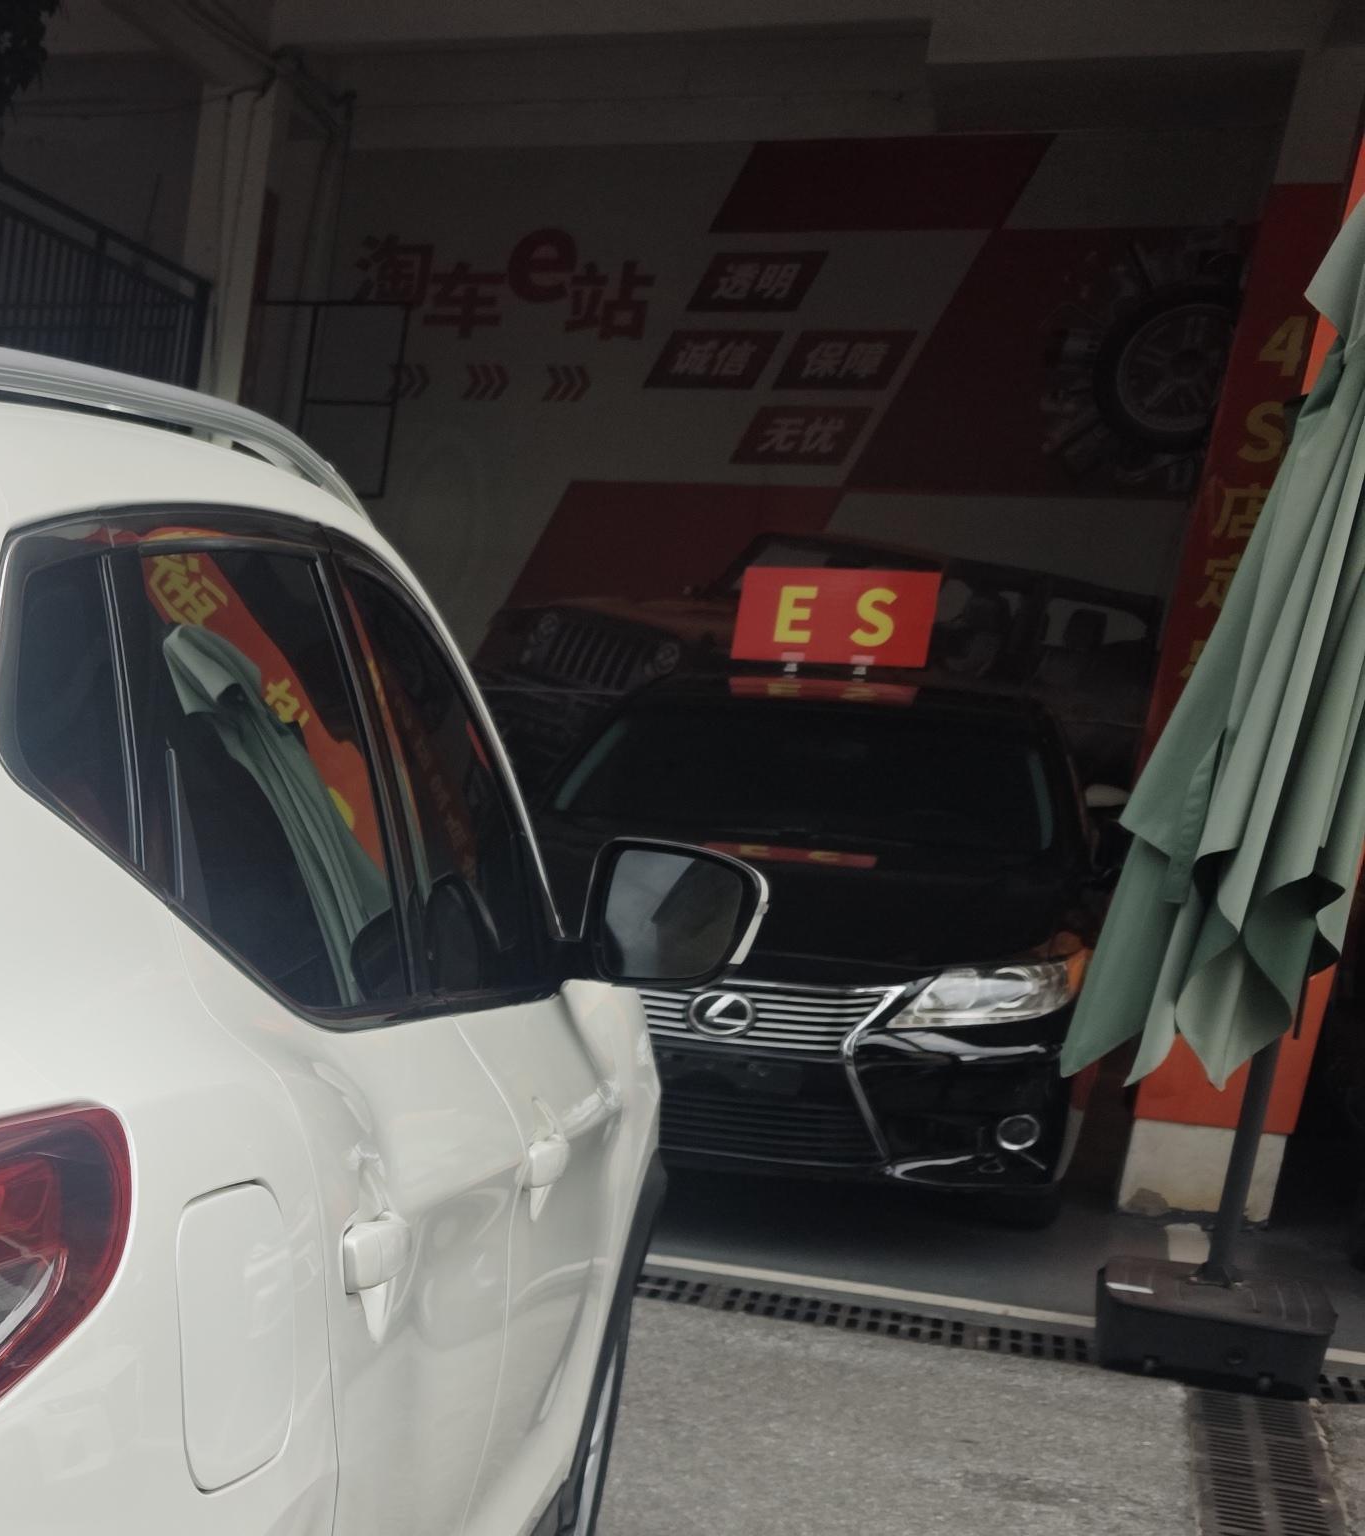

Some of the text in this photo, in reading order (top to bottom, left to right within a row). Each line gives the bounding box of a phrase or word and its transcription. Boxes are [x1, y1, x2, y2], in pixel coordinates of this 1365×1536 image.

[355, 228, 655, 340] 淘车e站
[710, 261, 802, 300] 透明
[668, 339, 758, 378] 诚信
[798, 339, 889, 379] 保障
[757, 415, 845, 454] 无忧
